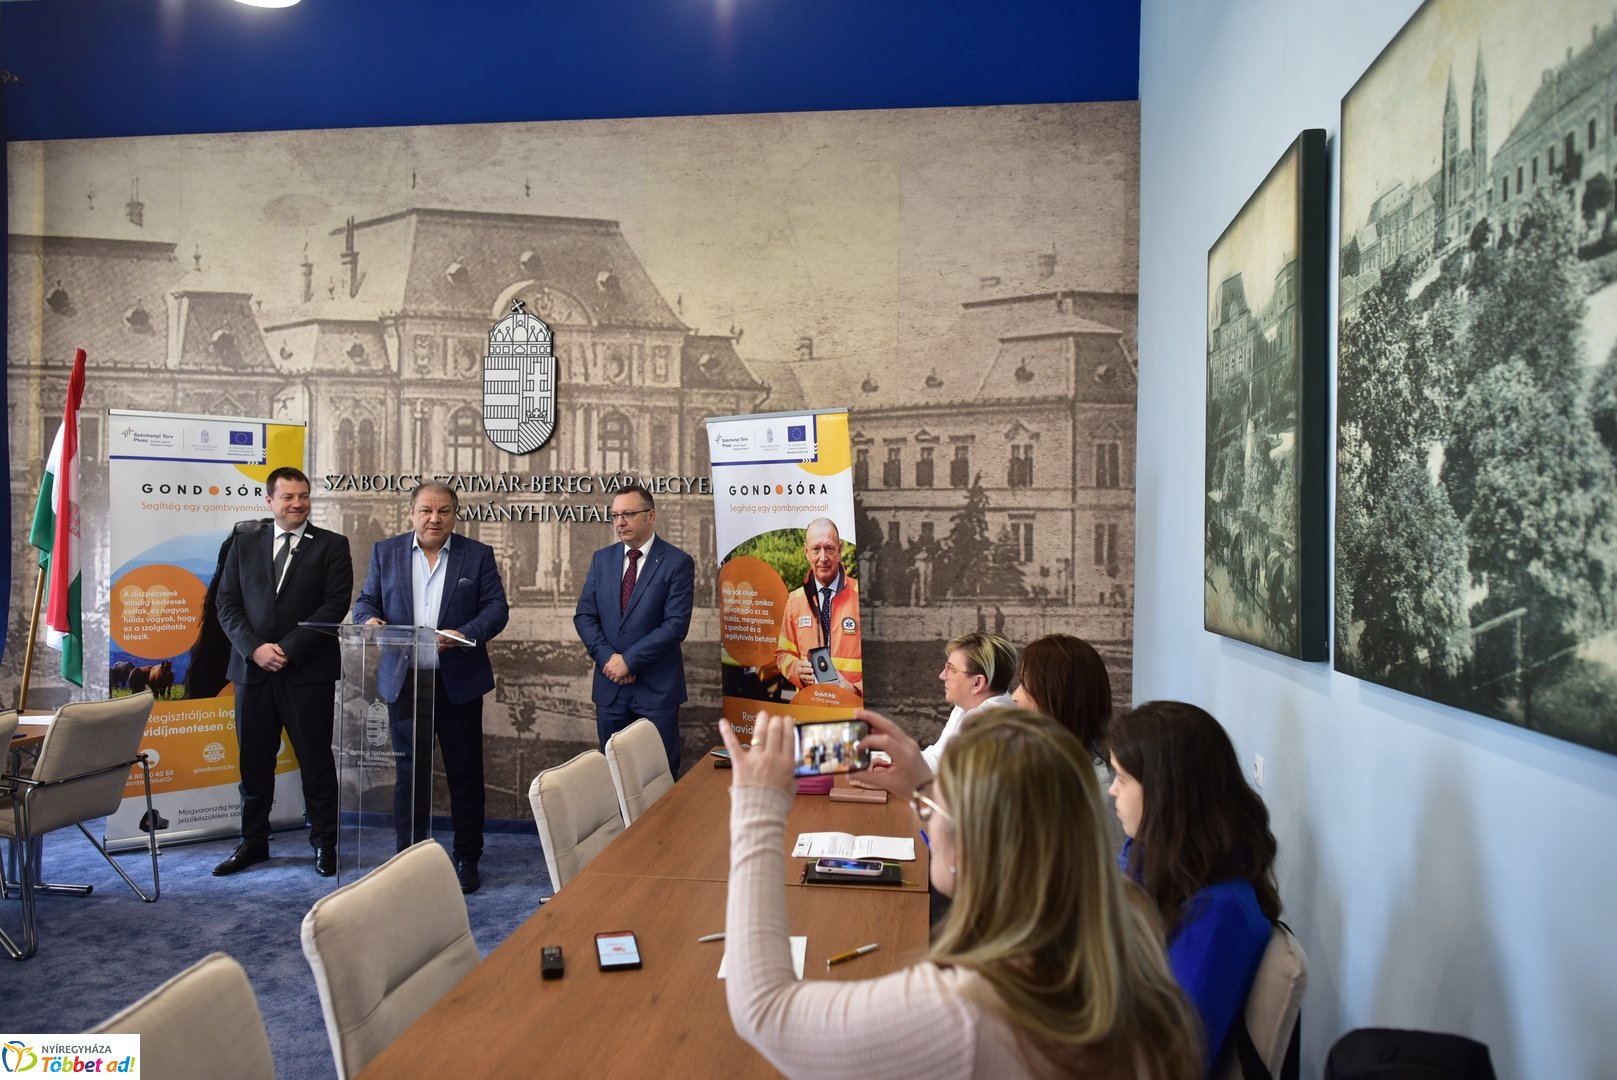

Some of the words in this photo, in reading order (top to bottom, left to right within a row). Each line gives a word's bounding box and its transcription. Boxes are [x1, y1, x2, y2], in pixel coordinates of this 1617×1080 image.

[142, 484, 262, 496] GONDOSÓR
[142, 502, 180, 512] Segítség
[184, 504, 200, 512] egy
[203, 502, 272, 512] gombnyomássa
[730, 504, 756, 513] Segítség
[758, 505, 770, 513] egy
[772, 504, 828, 513] gombnyomással!
[142, 624, 186, 632] szolgáltatás
[148, 710, 216, 724] Regisztráljon
[219, 708, 235, 718] ing
[144, 723, 223, 737] vidíjmentesen
[179, 804, 227, 815] Magyarország
